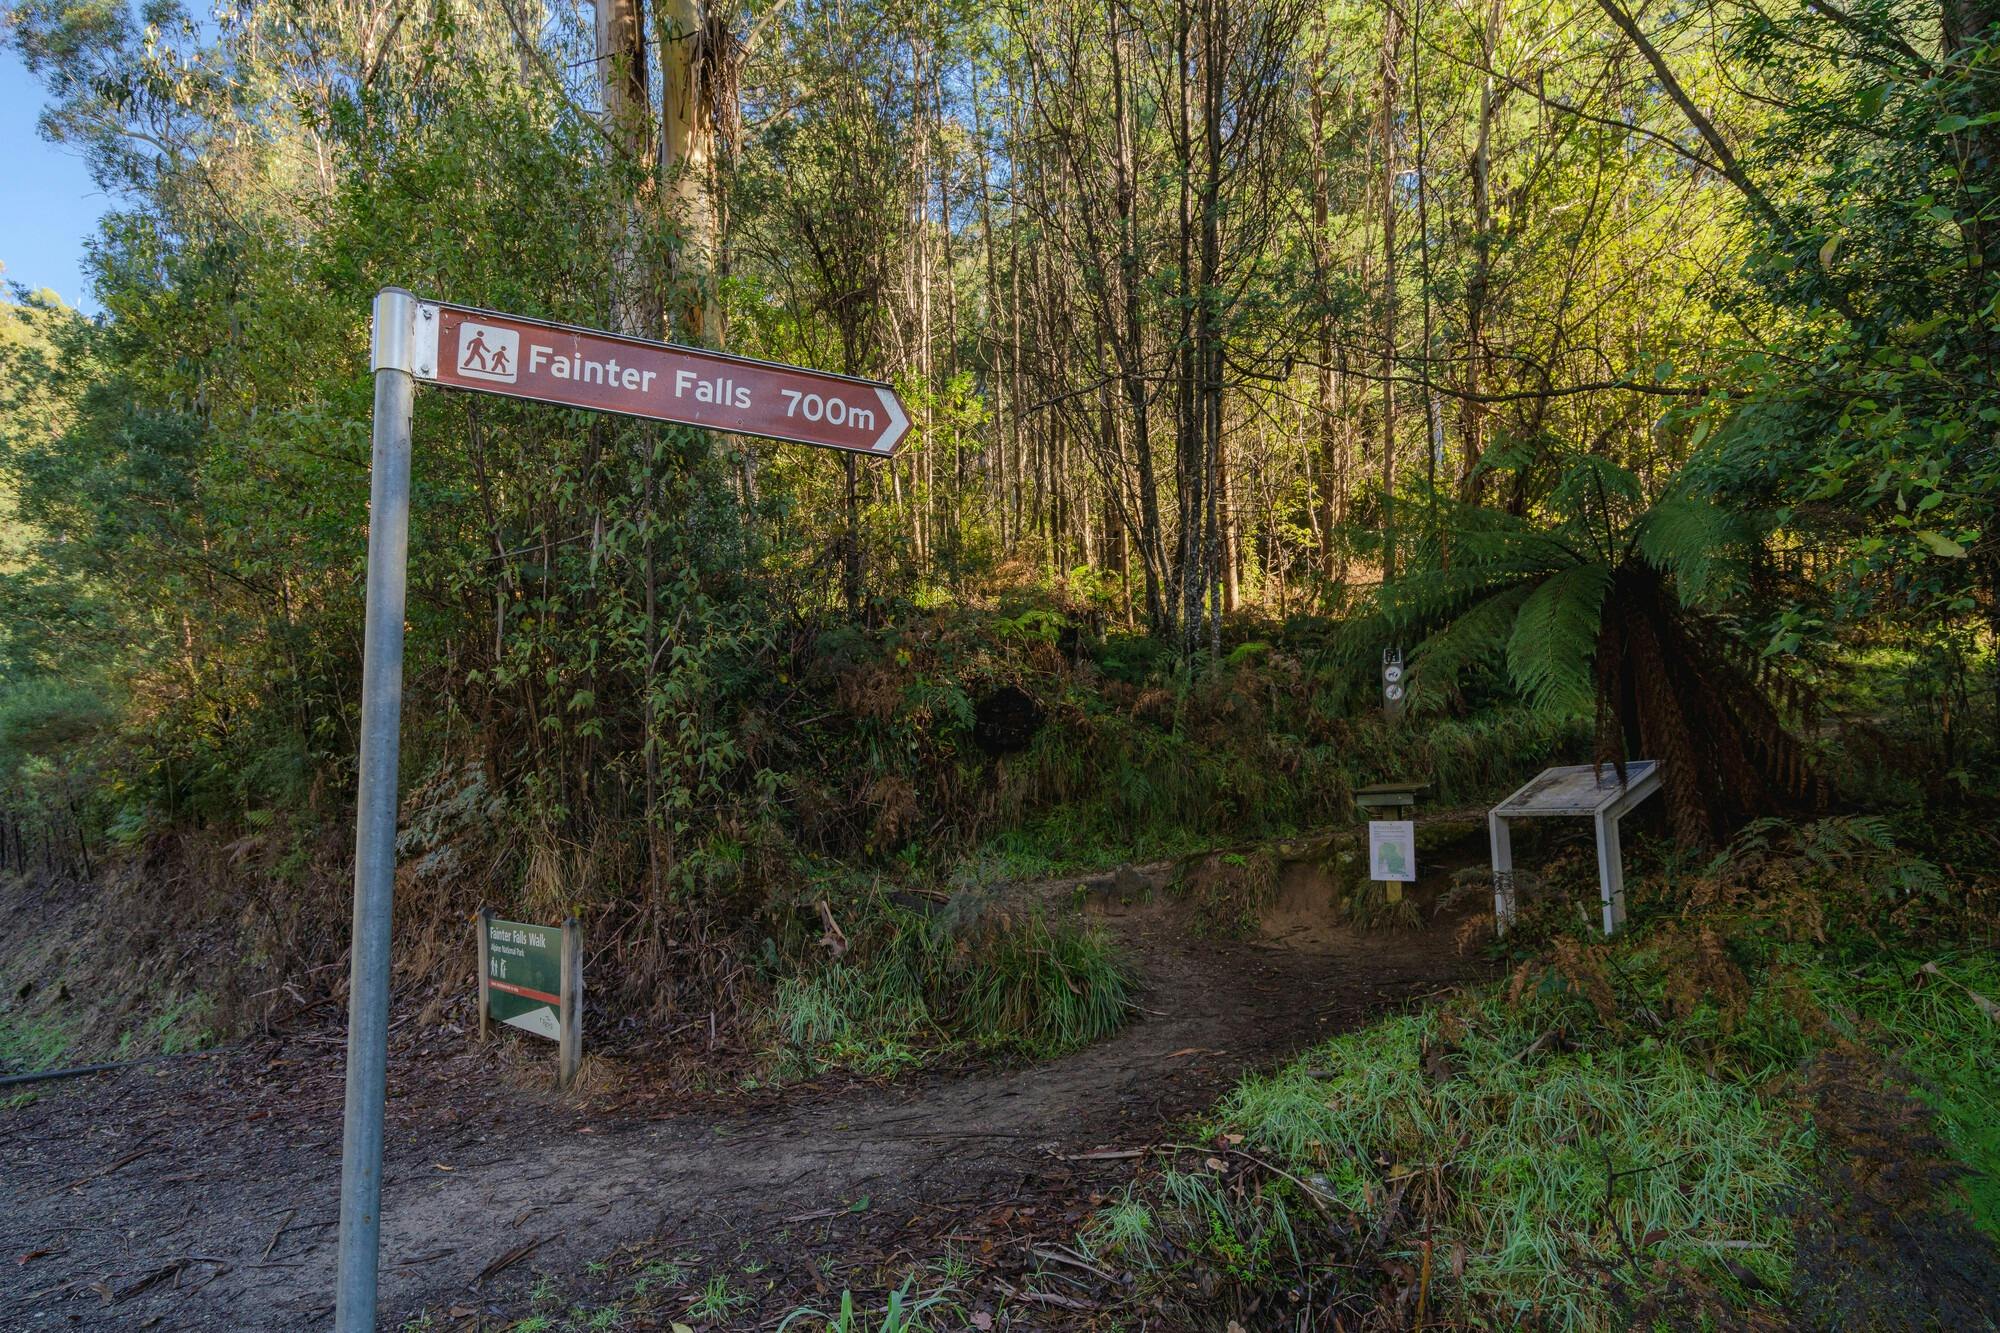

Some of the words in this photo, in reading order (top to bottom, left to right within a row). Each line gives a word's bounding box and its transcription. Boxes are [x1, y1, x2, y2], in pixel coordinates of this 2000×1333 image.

[528, 344, 656, 393] Fainter
[675, 369, 752, 409] Falls
[780, 389, 876, 431] 700m
[490, 926, 512, 942] Fainter
[513, 930, 527, 945] Falls
[528, 932, 546, 948] Walk
[501, 945, 516, 956] National
[516, 948, 525, 957] Park
